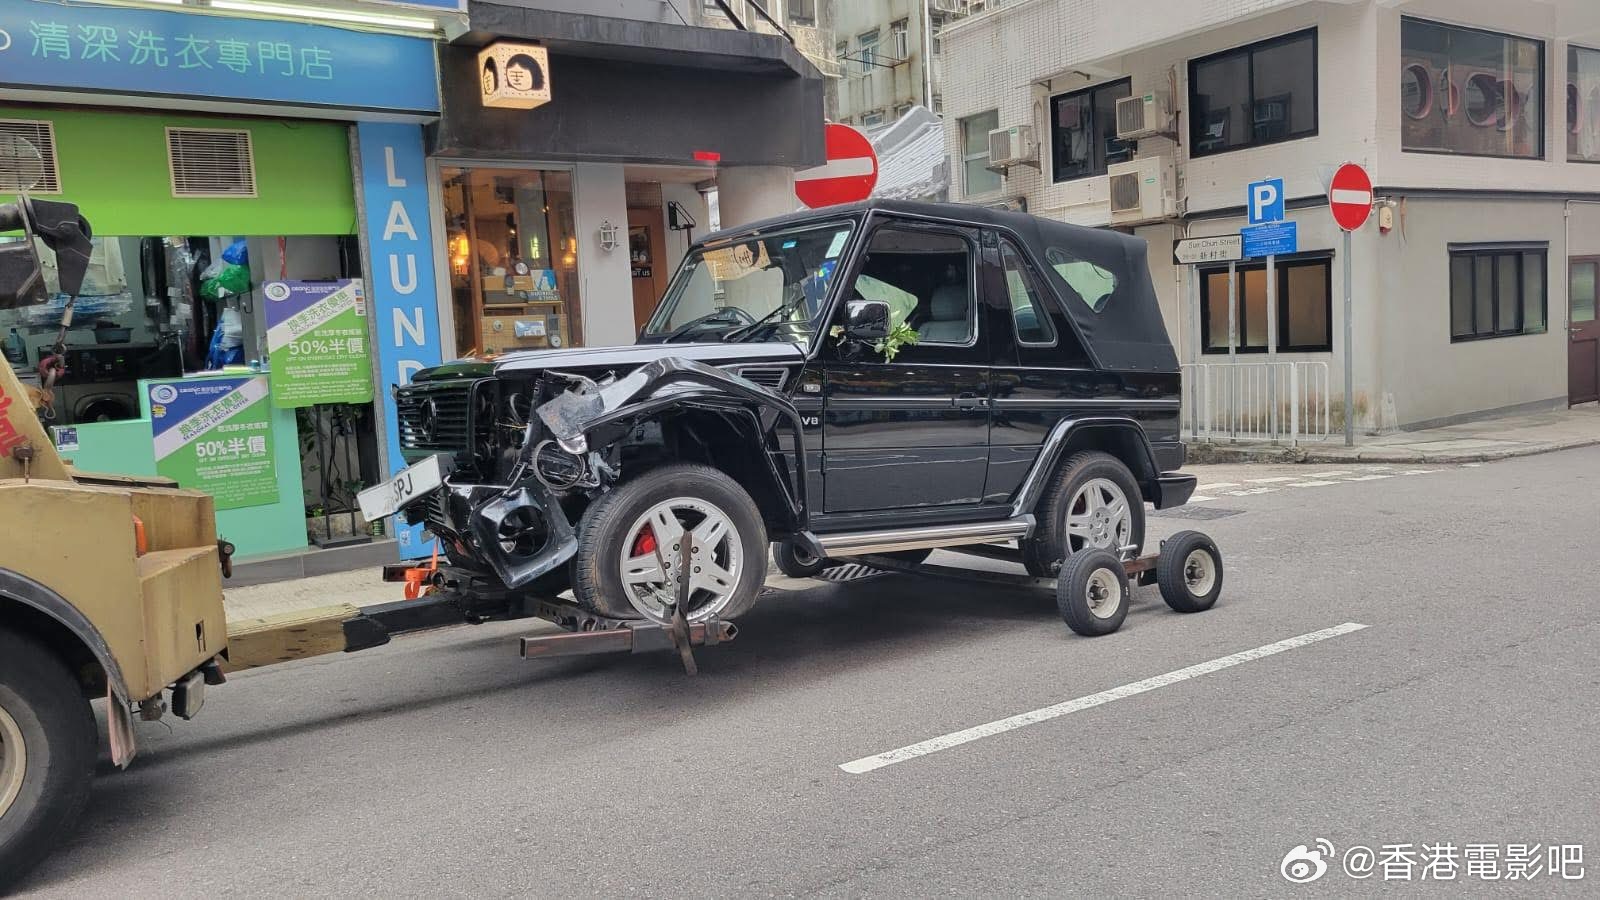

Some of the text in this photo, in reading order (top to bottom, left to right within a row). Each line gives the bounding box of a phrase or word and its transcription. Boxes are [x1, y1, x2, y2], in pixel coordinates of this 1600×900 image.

[29, 20, 333, 80] 清深洗衣專門店
[1254, 185, 1277, 220] P
[288, 338, 364, 355] 50%半價
[801, 416, 818, 425] V8
[196, 436, 267, 457] 50%半價
